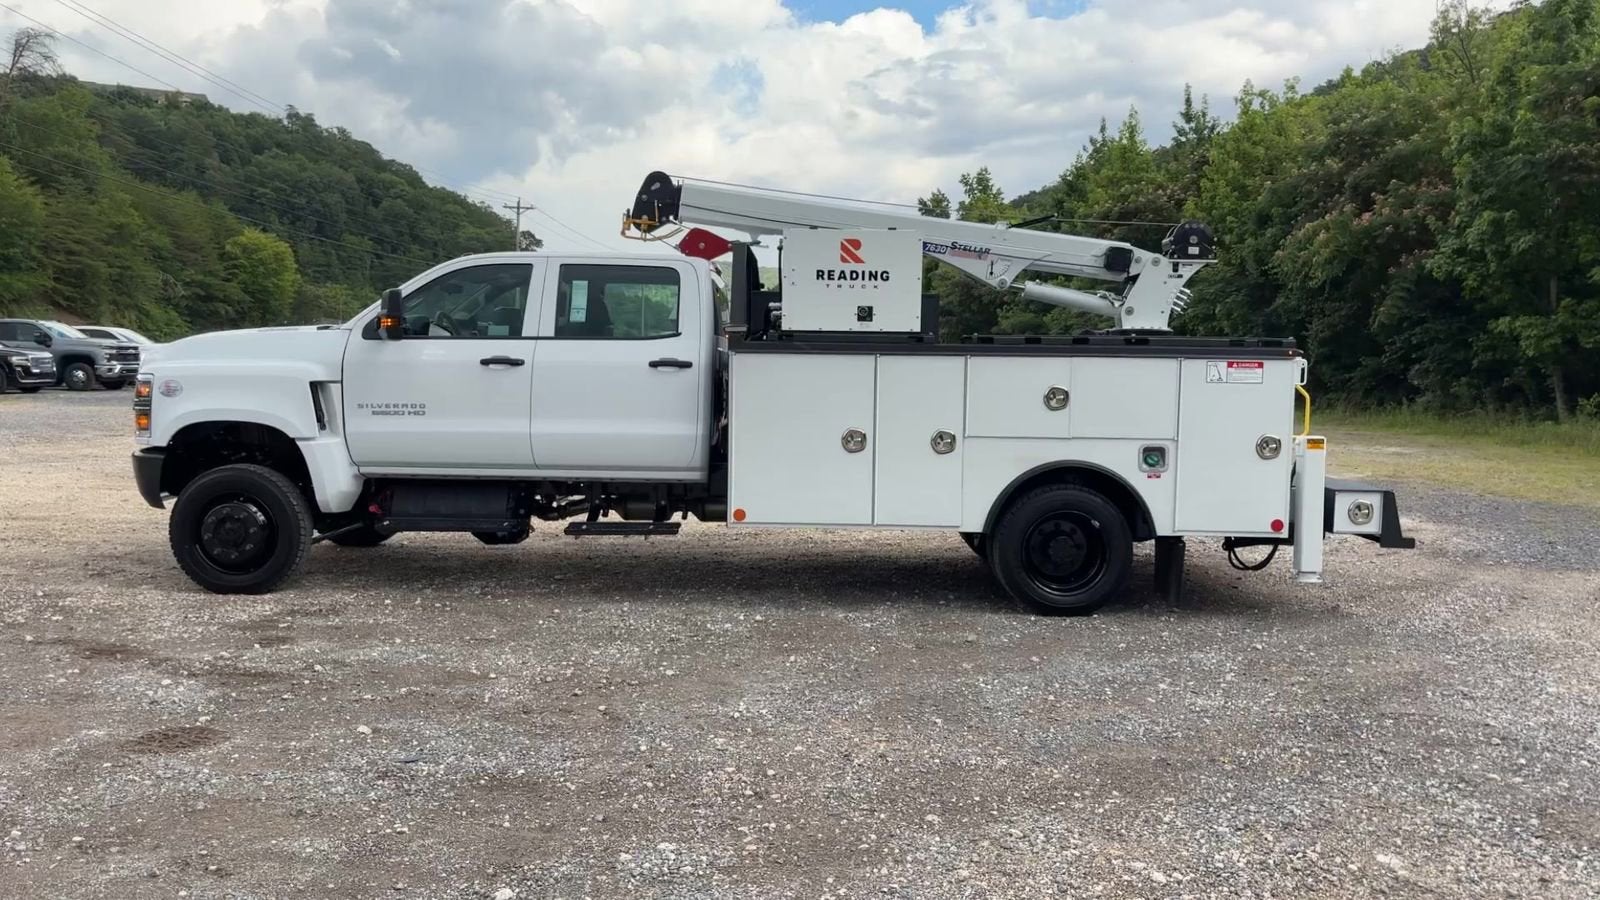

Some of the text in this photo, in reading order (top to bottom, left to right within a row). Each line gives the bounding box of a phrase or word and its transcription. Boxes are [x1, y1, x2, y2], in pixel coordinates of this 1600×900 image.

[925, 243, 947, 253] 7630
[951, 241, 991, 255] STELLAR
[816, 269, 890, 282] READING
